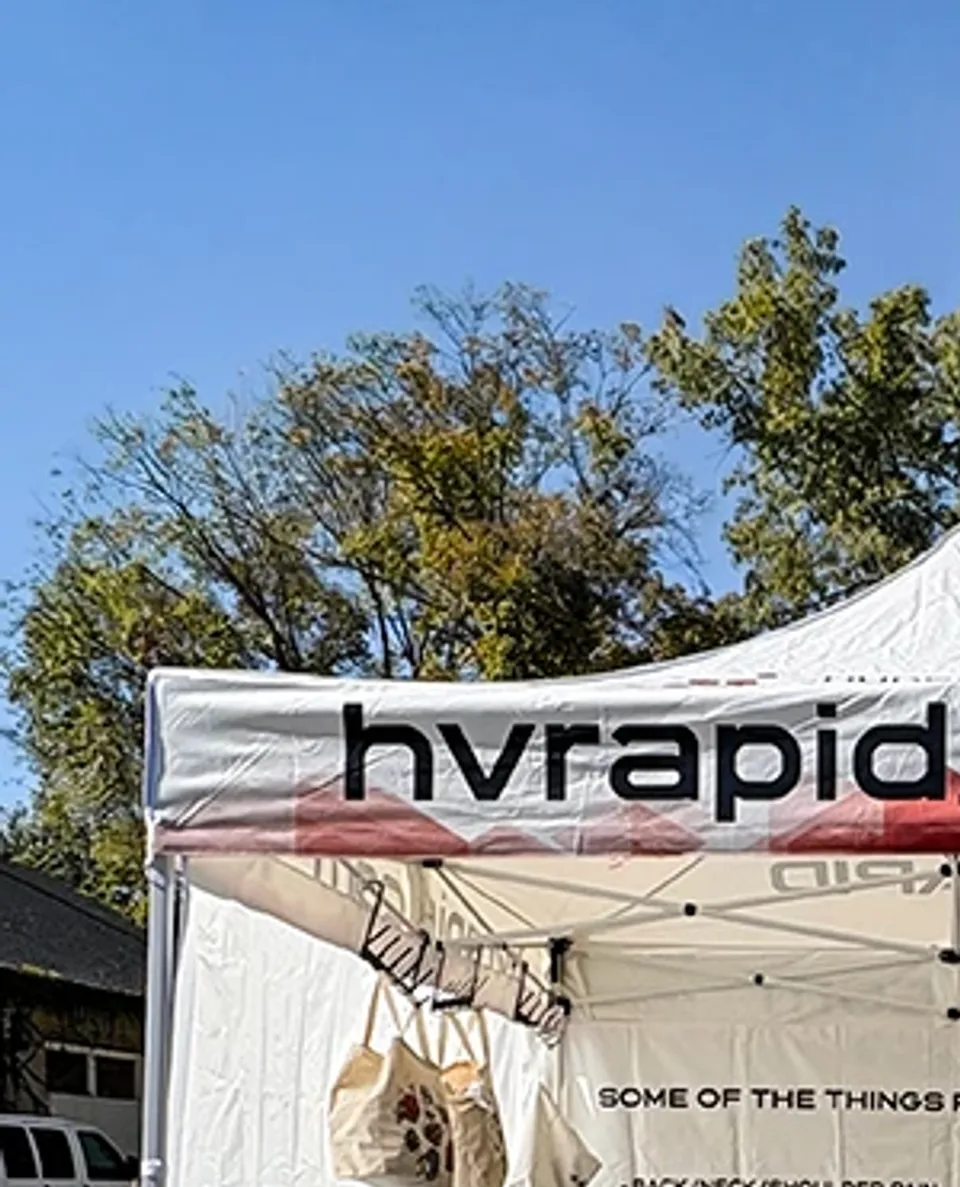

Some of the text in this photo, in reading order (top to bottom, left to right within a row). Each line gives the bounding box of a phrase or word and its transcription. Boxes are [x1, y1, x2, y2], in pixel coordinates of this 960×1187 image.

[598, 1087, 689, 1110] SOME
[696, 1087, 742, 1110] OF
[751, 1088, 816, 1111] THE
[825, 1089, 945, 1113] THINGS
